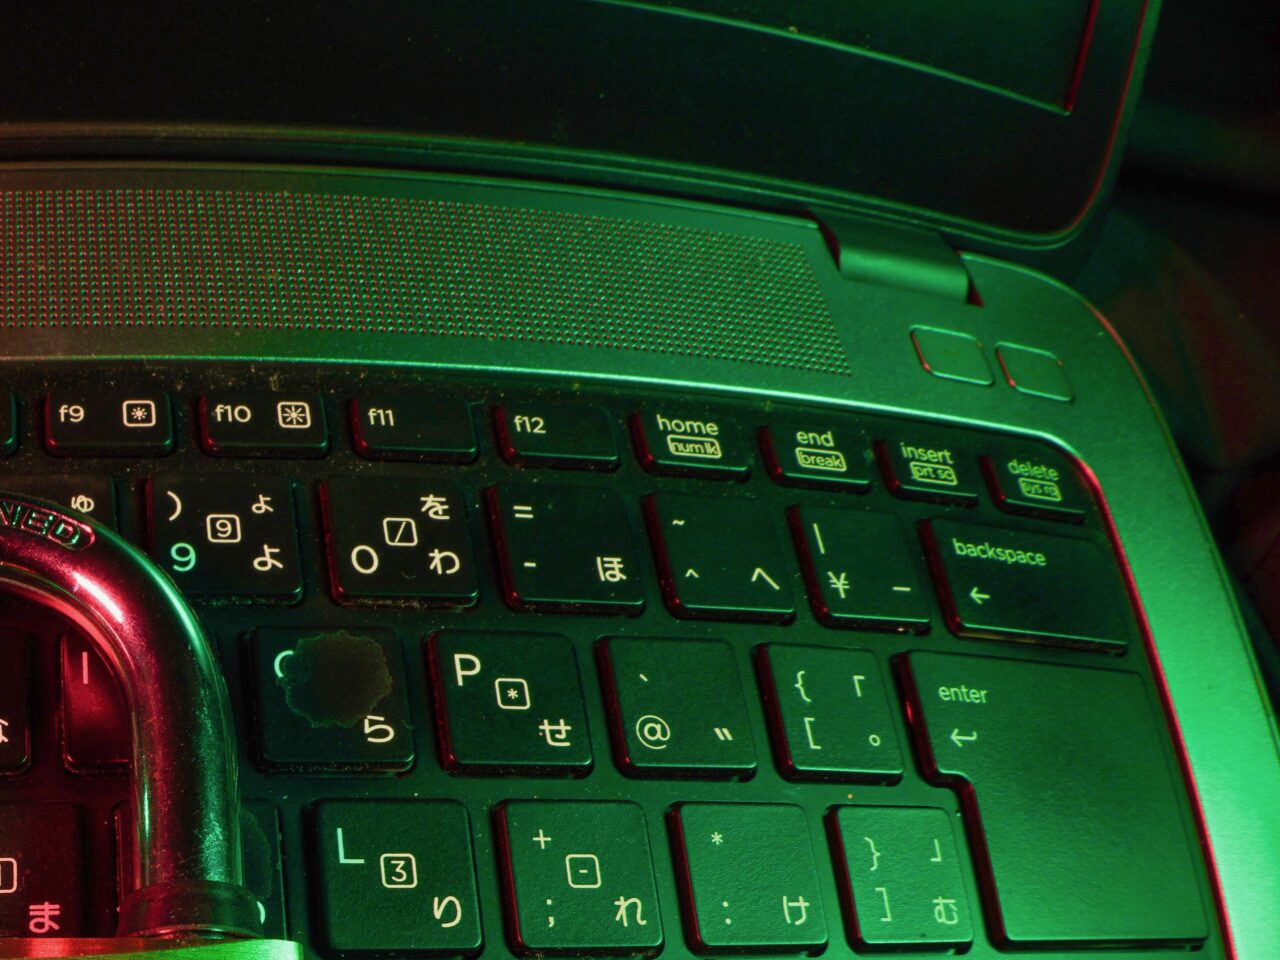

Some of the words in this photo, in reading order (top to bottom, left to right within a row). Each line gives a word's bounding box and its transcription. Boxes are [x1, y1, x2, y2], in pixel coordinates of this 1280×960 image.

[59, 405, 84, 422] f9
[215, 405, 251, 422] f10
[368, 408, 394, 426] f11
[514, 416, 546, 433] f12
[657, 414, 718, 435] home
[797, 431, 834, 447] end
[799, 452, 842, 467] break
[900, 443, 953, 464] insert
[1008, 460, 1058, 480] delete
[167, 491, 181, 520] )
[421, 494, 450, 519] を
[216, 520, 231, 537] 9
[171, 543, 195, 571] 9
[253, 545, 283, 571] よ
[351, 545, 378, 574] 0
[429, 549, 459, 574] わ
[953, 538, 1046, 566] backspace
[597, 557, 626, 582] ほ
[828, 572, 849, 598] ¥
[454, 654, 481, 686] P
[795, 671, 811, 702] {
[939, 685, 987, 703] enter
[364, 715, 394, 742] ら
[539, 719, 571, 746] せ
[636, 715, 670, 749] @
[804, 717, 821, 749] [
[337, 828, 364, 863] L
[533, 829, 551, 849] +
[864, 837, 880, 871] }
[391, 861, 406, 882] 3
[29, 902, 60, 933] ま
[434, 896, 461, 927] り
[547, 899, 554, 927] ;
[614, 896, 646, 927] れ
[723, 902, 731, 924] :
[783, 896, 809, 925] け
[875, 888, 891, 921] ]
[933, 897, 958, 924] む
